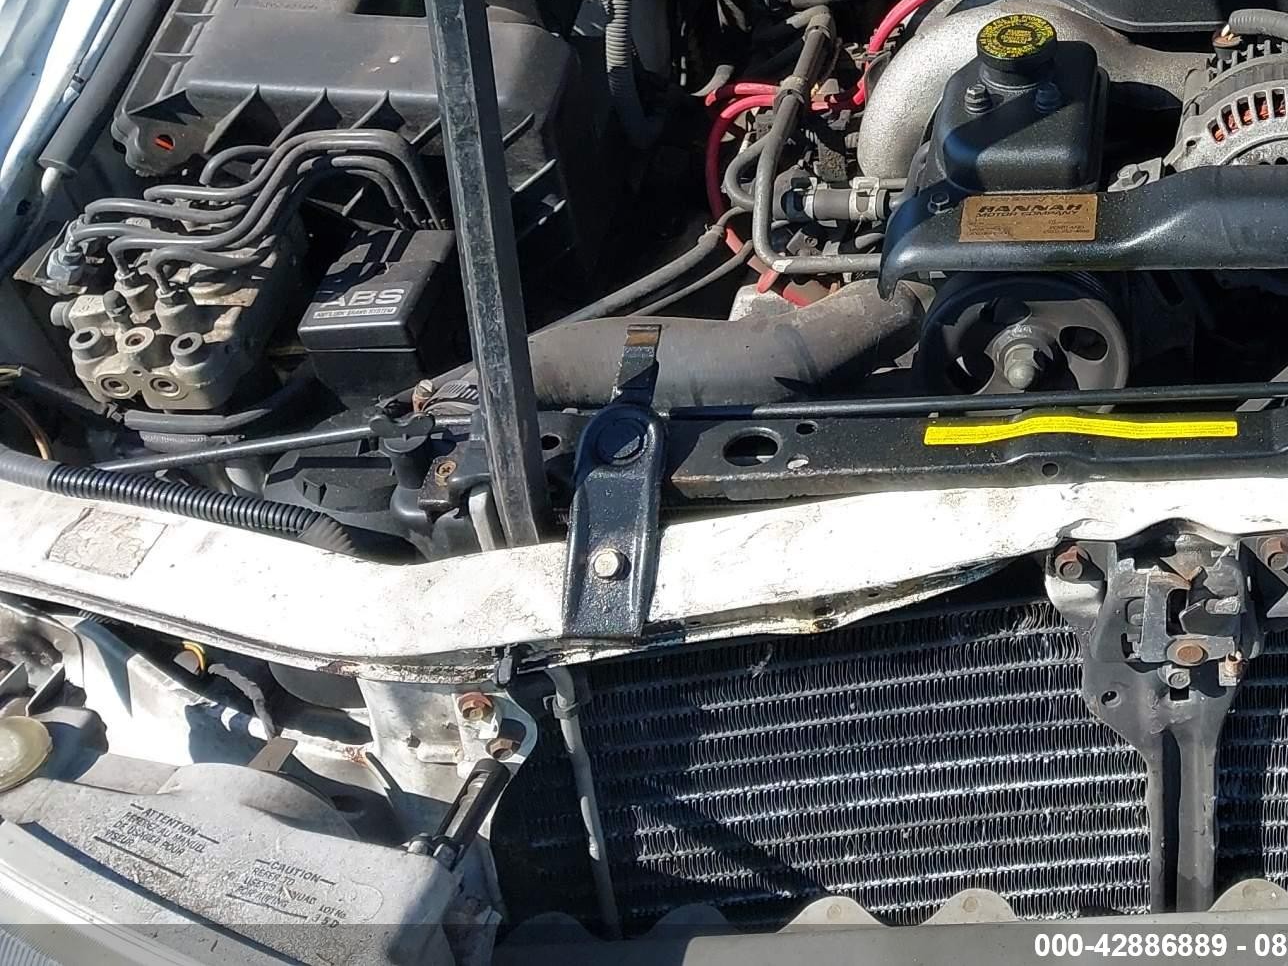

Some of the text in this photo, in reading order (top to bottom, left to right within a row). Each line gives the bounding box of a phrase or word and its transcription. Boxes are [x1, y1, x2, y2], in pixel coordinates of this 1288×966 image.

[978, 203, 1083, 213] HANNAH
[320, 288, 405, 307] ABS
[142, 808, 199, 836] ATTENTION
[270, 862, 321, 883] CAUTION
